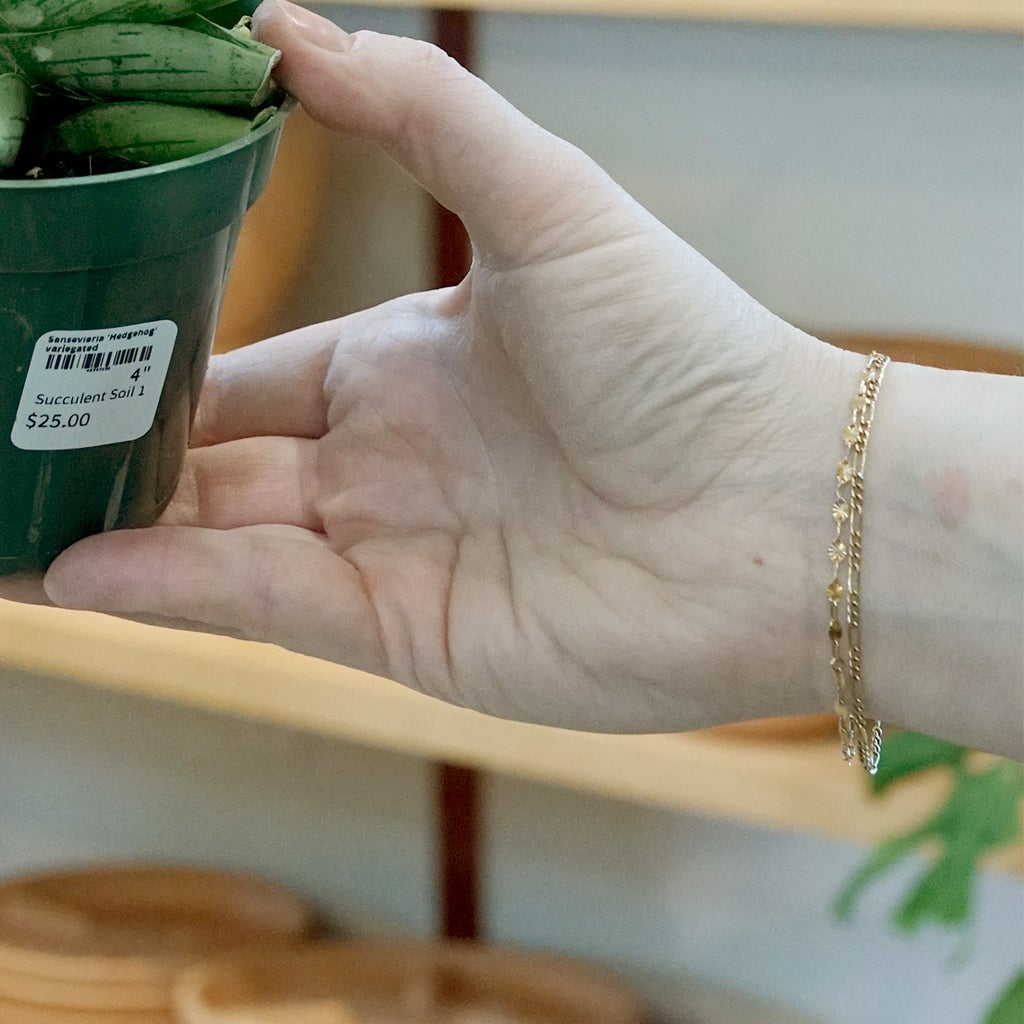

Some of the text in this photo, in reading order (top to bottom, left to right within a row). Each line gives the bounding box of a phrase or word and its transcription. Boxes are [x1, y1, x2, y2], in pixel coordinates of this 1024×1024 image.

[48, 335, 104, 343] Sansevieria
[45, 344, 99, 354] variegated
[130, 366, 151, 382] 4"
[35, 385, 145, 405] Succulent Soil 1
[26, 412, 91, 429] $25.00
